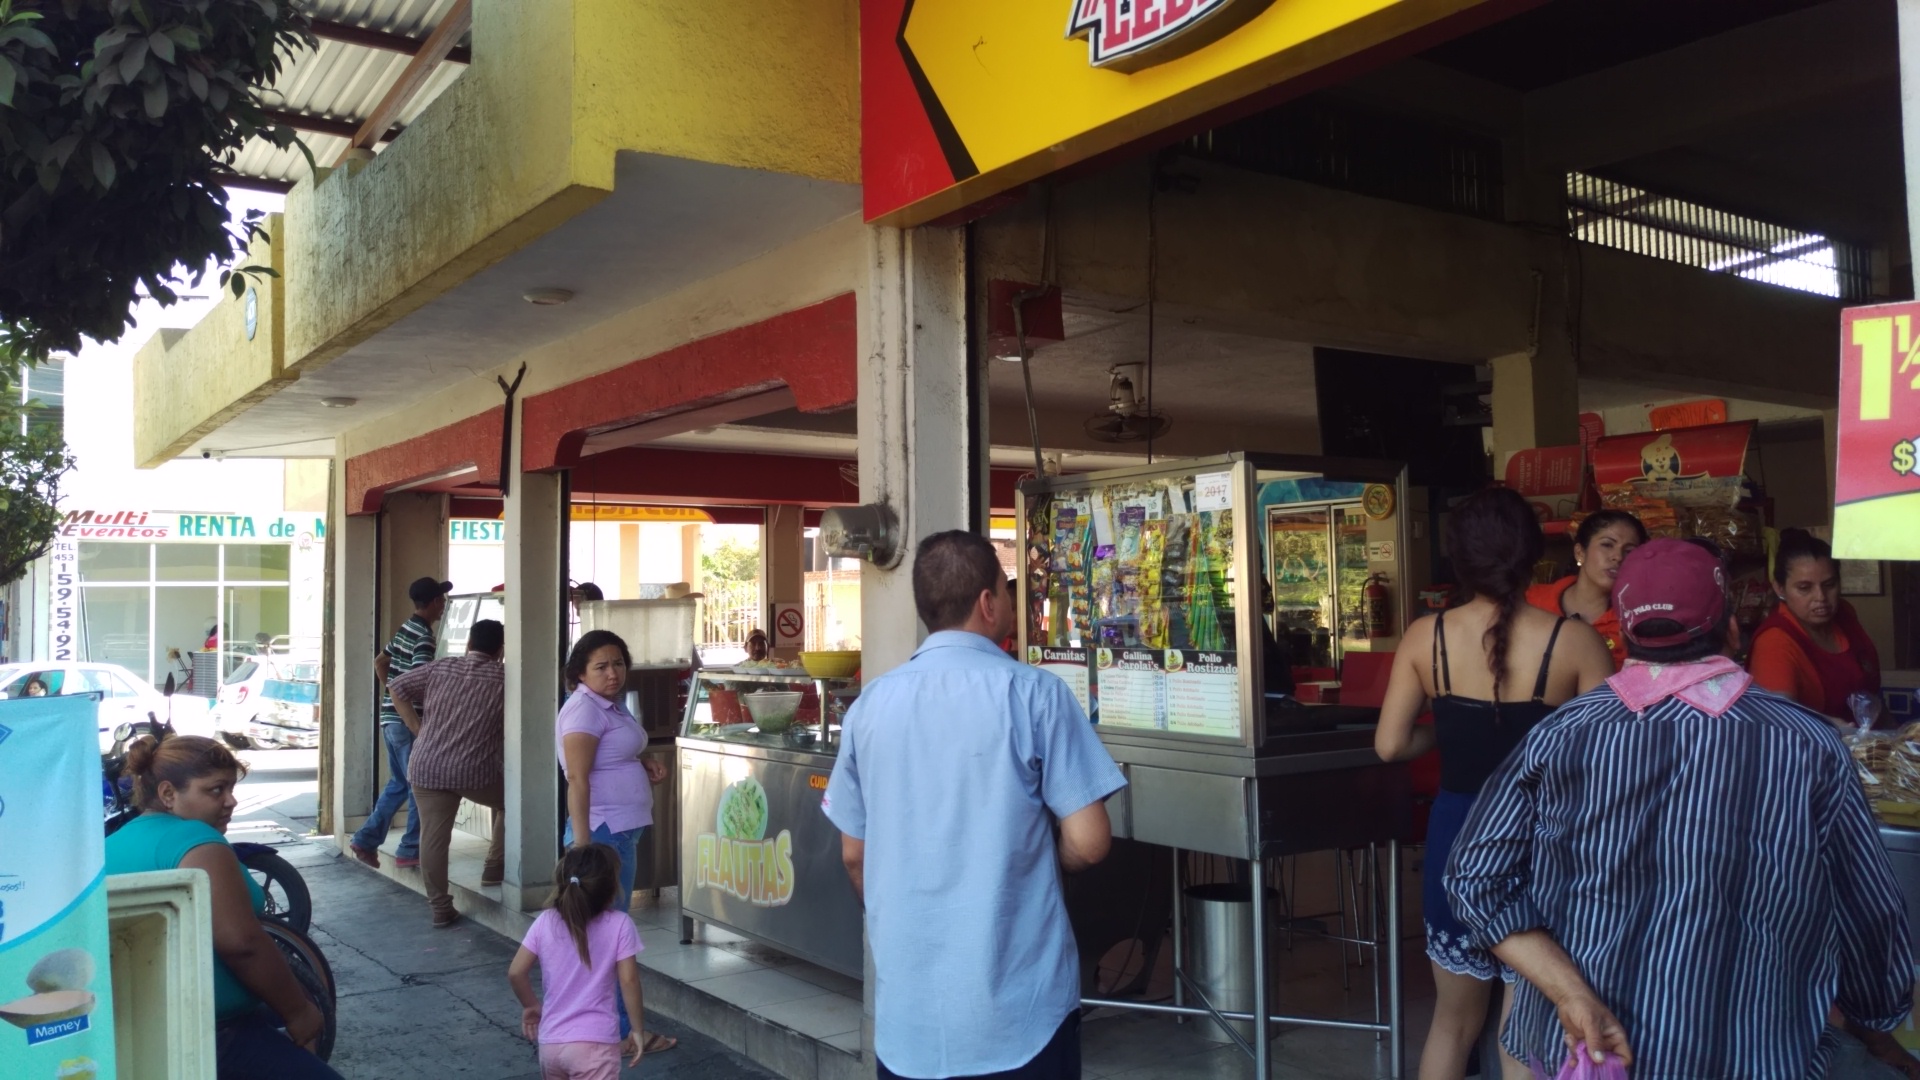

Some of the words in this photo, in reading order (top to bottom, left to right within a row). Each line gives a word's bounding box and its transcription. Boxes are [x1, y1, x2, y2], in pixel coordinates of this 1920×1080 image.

[1204, 485, 1227, 498] 2017
[58, 510, 149, 527] Multi
[61, 524, 169, 538] Eventos
[179, 515, 256, 537] RENTA
[268, 517, 296, 538] de
[450, 520, 505, 540] FIEST
[1632, 604, 1651, 616] POLO
[1652, 603, 1674, 611] CLUB
[1043, 649, 1086, 662] Carnitas
[1122, 651, 1153, 661] Gallina
[1198, 653, 1222, 663] Pollo
[1186, 662, 1238, 674] Rostizado
[696, 829, 795, 908] FLAUTAS
[35, 1018, 81, 1038] Mamey
